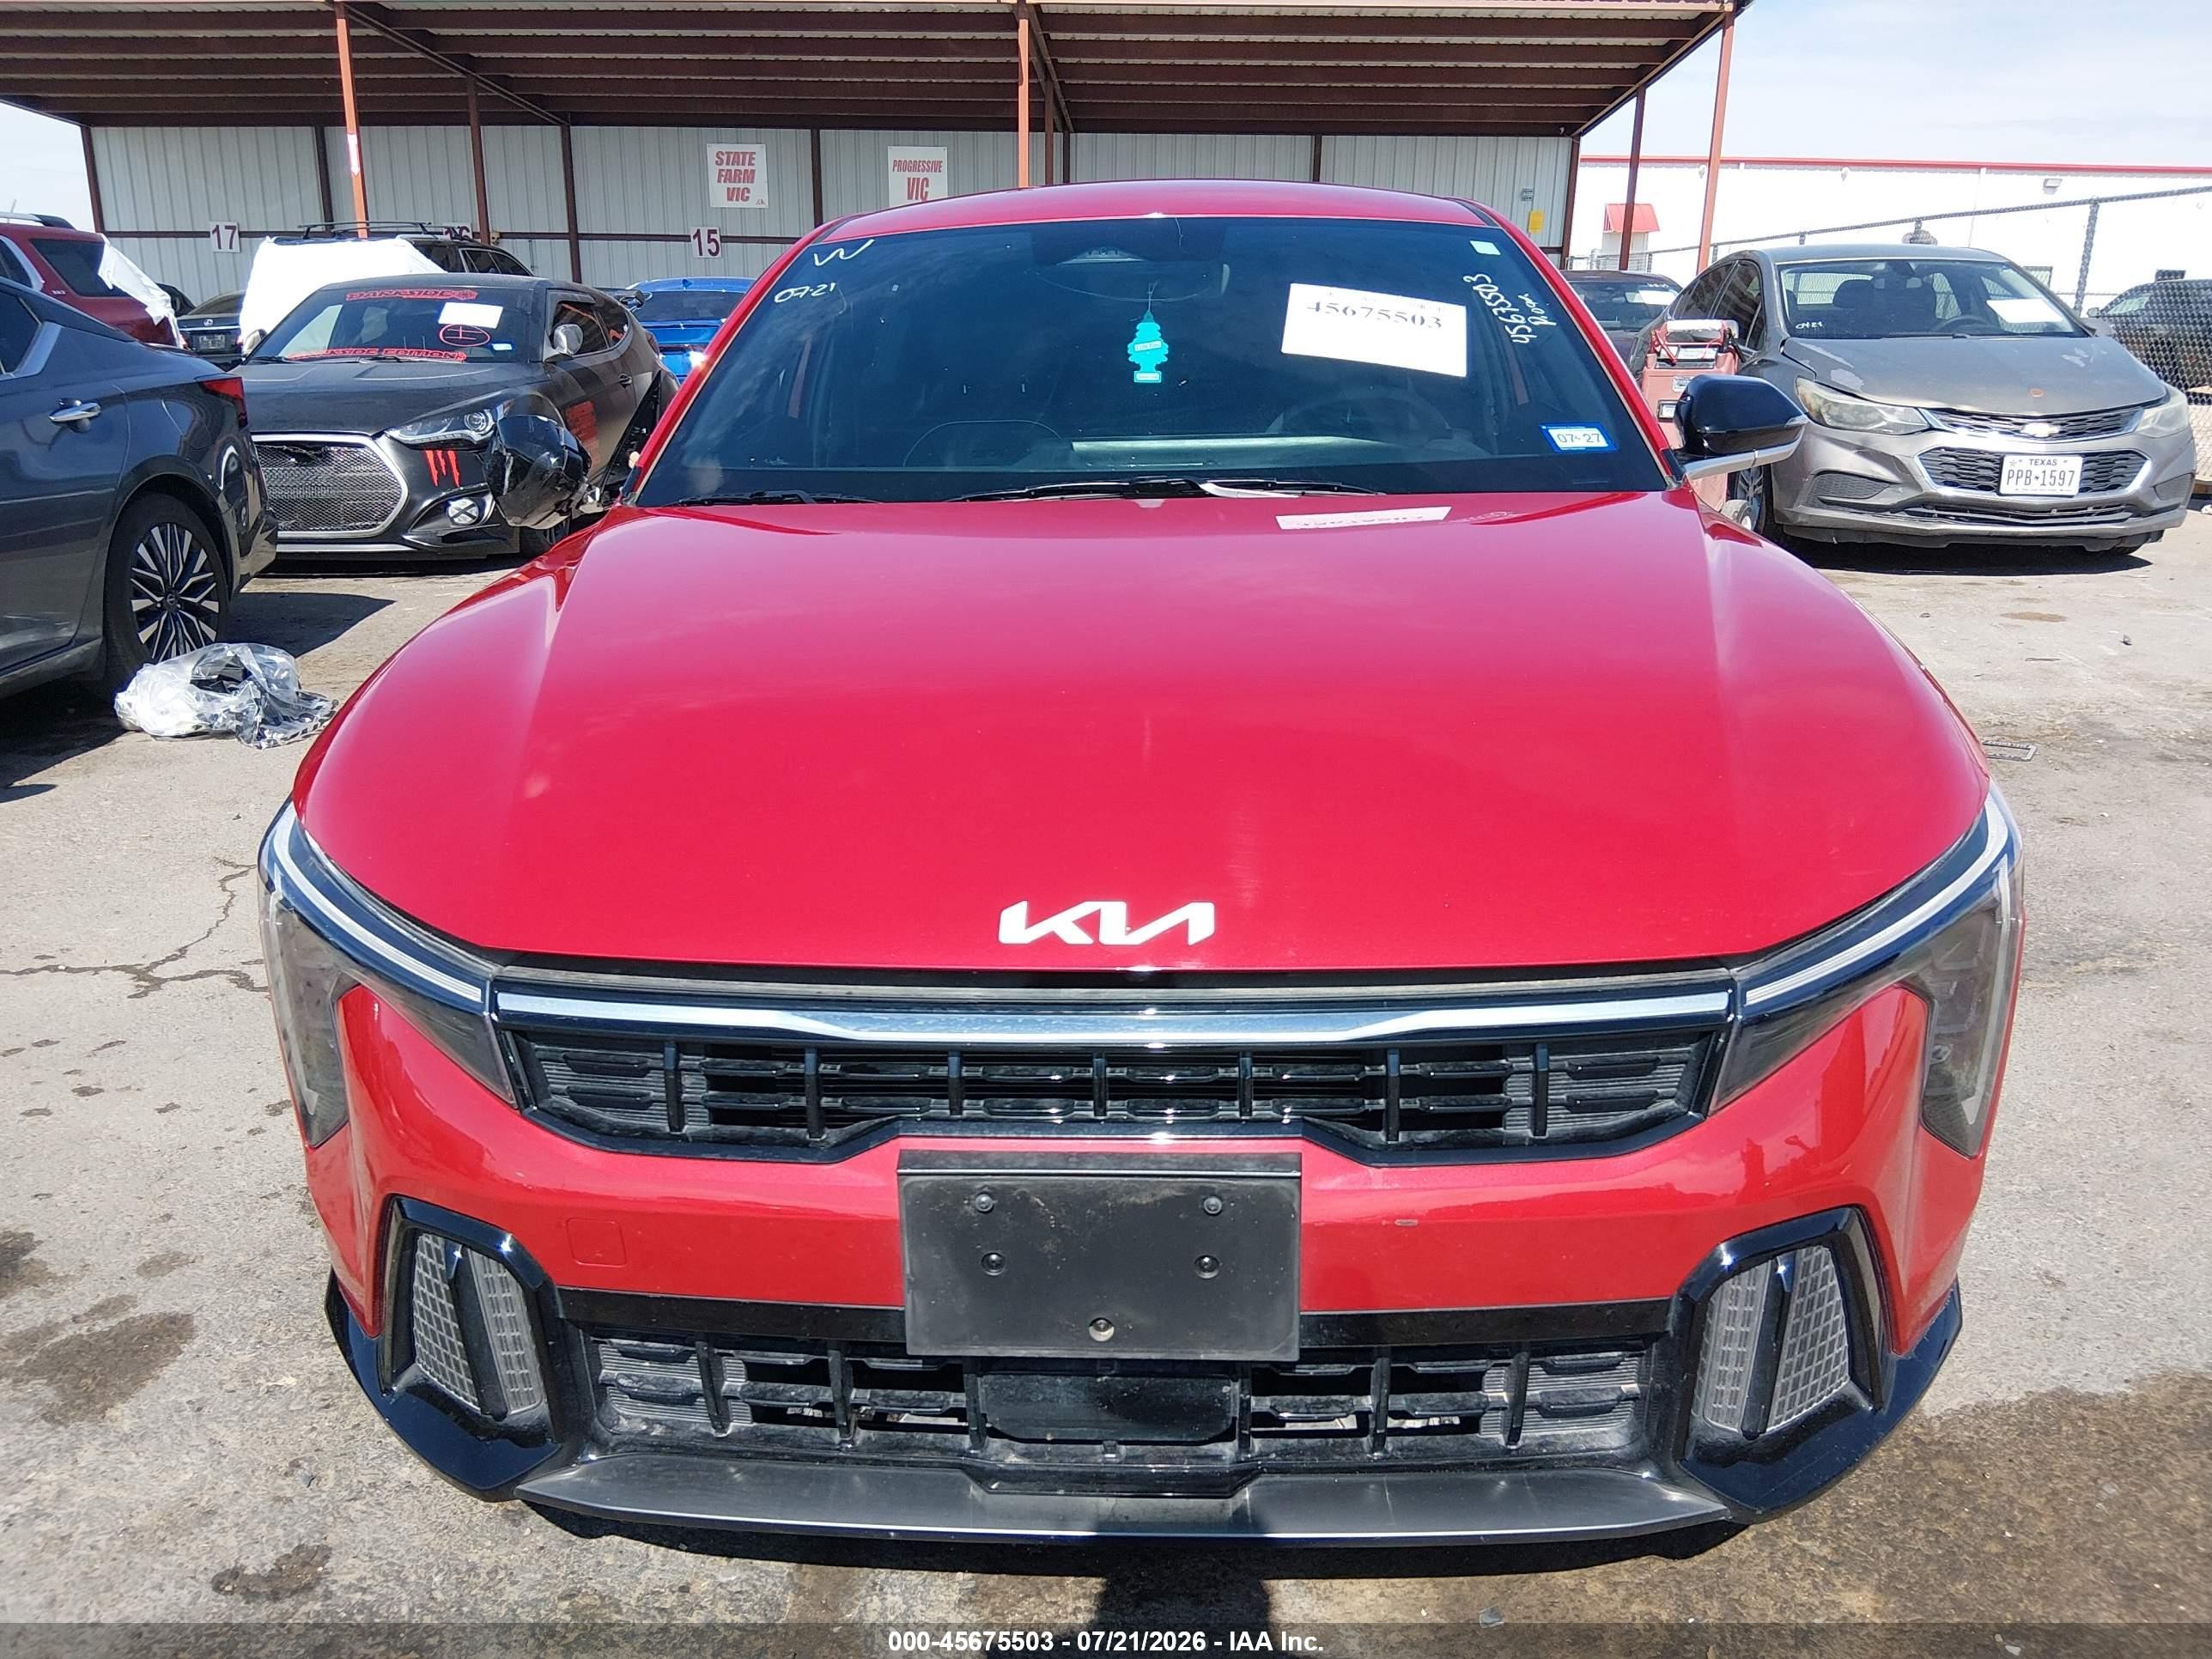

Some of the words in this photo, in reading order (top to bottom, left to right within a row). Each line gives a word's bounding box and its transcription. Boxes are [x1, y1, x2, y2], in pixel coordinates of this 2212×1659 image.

[714, 150, 757, 166] STATE
[892, 159, 943, 173] PROGRESSIVE
[717, 168, 757, 185] FARM
[726, 186, 751, 203] VIC
[907, 177, 929, 202] VIC
[212, 224, 237, 250] 17
[691, 228, 720, 257] 15
[1306, 301, 1443, 330] 45675503
[1462, 273, 1538, 343] 45675503
[998, 900, 1216, 946] KIA
